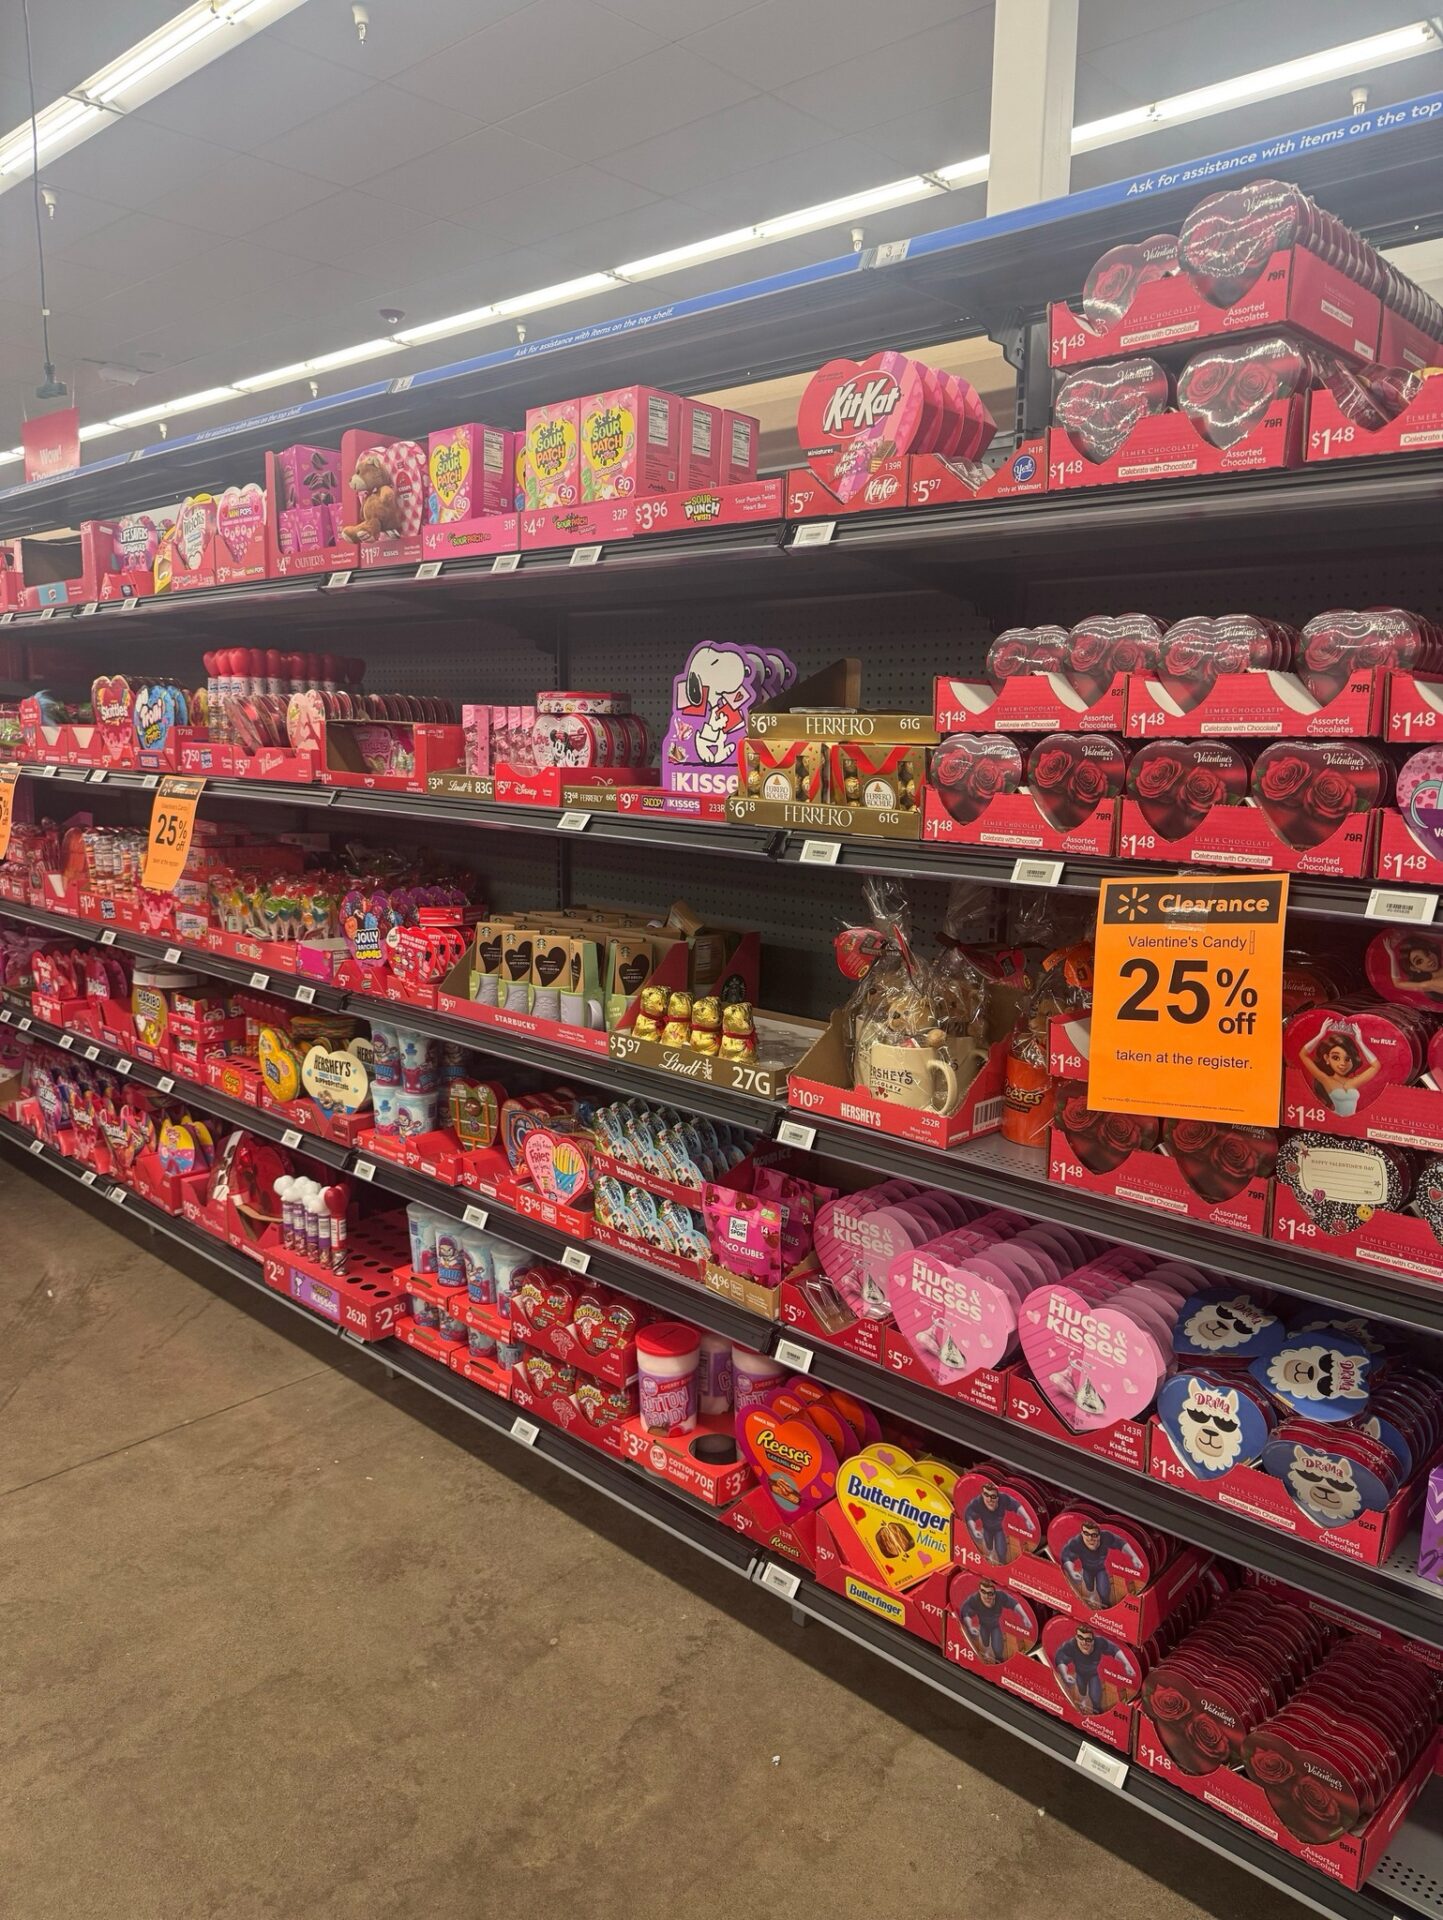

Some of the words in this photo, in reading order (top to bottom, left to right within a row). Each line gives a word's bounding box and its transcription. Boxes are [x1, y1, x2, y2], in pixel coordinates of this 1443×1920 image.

[1127, 179, 1153, 196] Ask
[1157, 173, 1178, 189] for
[1182, 154, 1257, 181] assistance
[1262, 139, 1296, 161] with
[1300, 126, 1346, 149] items
[1350, 118, 1372, 135] on
[1376, 108, 1406, 130] the
[1411, 100, 1441, 126] top
[514, 349, 527, 358] Ask
[528, 346, 539, 354] for
[539, 336, 574, 352] assistance
[574, 331, 589, 341] with
[590, 325, 611, 337] items
[612, 323, 622, 331] on
[623, 319, 637, 328] the
[638, 315, 651, 326] top
[823, 376, 902, 433] KitKat
[591, 418, 621, 438] SOUR
[1263, 418, 1283, 428] 79R
[537, 430, 564, 450] SOUR
[591, 435, 623, 454] PATCH
[535, 446, 566, 463] PATCH
[1220, 456, 1266, 467] Chocolates
[1225, 448, 1262, 459] Assorted
[884, 461, 902, 470] 139R
[1120, 465, 1148, 476] Celebrate
[1149, 464, 1162, 473] with
[560, 486, 573, 499] 20
[617, 479, 631, 492] 20
[1018, 482, 1042, 491] Walmart
[691, 494, 712, 505] SOUR
[612, 509, 628, 521] 32P
[685, 504, 720, 519] PUNCH
[504, 519, 516, 530] 31P
[1350, 683, 1370, 693] 79R
[805, 717, 874, 736] FERRERO
[900, 718, 920, 730] 61G
[1306, 725, 1354, 734] Chocolates
[1311, 716, 1350, 726] Assorted
[1193, 751, 1233, 764] Valentine's
[1323, 752, 1365, 766] Valentine's
[475, 782, 493, 795] 83G
[766, 784, 789, 796] FERRERO
[866, 792, 892, 803] FERRERO
[784, 805, 852, 827] FERRERO
[878, 813, 899, 824] 61G
[1061, 843, 1099, 853] Chocolates
[1192, 852, 1221, 862] Celebrate
[1222, 854, 1236, 863] with
[1301, 855, 1340, 866] Assorted
[1297, 862, 1344, 874] Chocolates
[1157, 894, 1270, 913] Clearance
[355, 929, 379, 944] JOLLY
[1128, 935, 1198, 948] Valentine's
[1202, 935, 1247, 951] Candy
[1116, 958, 1258, 1025] 25%
[494, 1014, 537, 1030] STARBUCKS
[1218, 1012, 1256, 1035] off
[314, 1054, 351, 1077] HERSHEY'S
[659, 1050, 701, 1077] Lindt
[1116, 1049, 1152, 1063] taken
[1156, 1052, 1169, 1064] at
[1172, 1053, 1194, 1065] the
[1197, 1055, 1253, 1070] register.
[732, 1066, 770, 1095] 27G
[840, 1102, 881, 1127] HERSHEY'S
[921, 1117, 940, 1128] 252R
[1247, 1189, 1265, 1201] 79R
[1209, 1213, 1252, 1230] Chocolates
[1213, 1207, 1248, 1222] Assorted
[833, 1212, 880, 1237] HUGS
[1358, 1249, 1391, 1264] Celebrate
[1391, 1258, 1406, 1267] with
[913, 1263, 967, 1298] HUGS
[346, 1305, 368, 1328] 262R
[1049, 1299, 1111, 1340] HUGS
[981, 1372, 1000, 1384] 143R
[1113, 1431, 1134, 1444] HUGS
[1122, 1424, 1142, 1437] 143R
[756, 1429, 812, 1466] Reese's
[668, 1457, 695, 1476] COTTON
[668, 1465, 689, 1482] CANDY
[790, 1462, 802, 1472] CUP
[694, 1470, 714, 1492] 70R
[847, 1474, 950, 1531] Butterfinger
[769, 1535, 800, 1558] Reese's
[916, 1530, 947, 1554] Minis
[1318, 1535, 1364, 1559] Chocolates
[1323, 1530, 1361, 1550] Assorted
[848, 1582, 903, 1617] Butterfinger
[920, 1600, 944, 1620] 147R
[1090, 1616, 1127, 1638] Chocolates
[1093, 1613, 1123, 1630] Assorted
[1200, 1699, 1236, 1725] Valentine's
[1081, 1721, 1118, 1744] Chocolates
[1085, 1717, 1114, 1735] Assorted
[1303, 1761, 1343, 1789] Valentine's
[1303, 1846, 1341, 1870] Assorted
